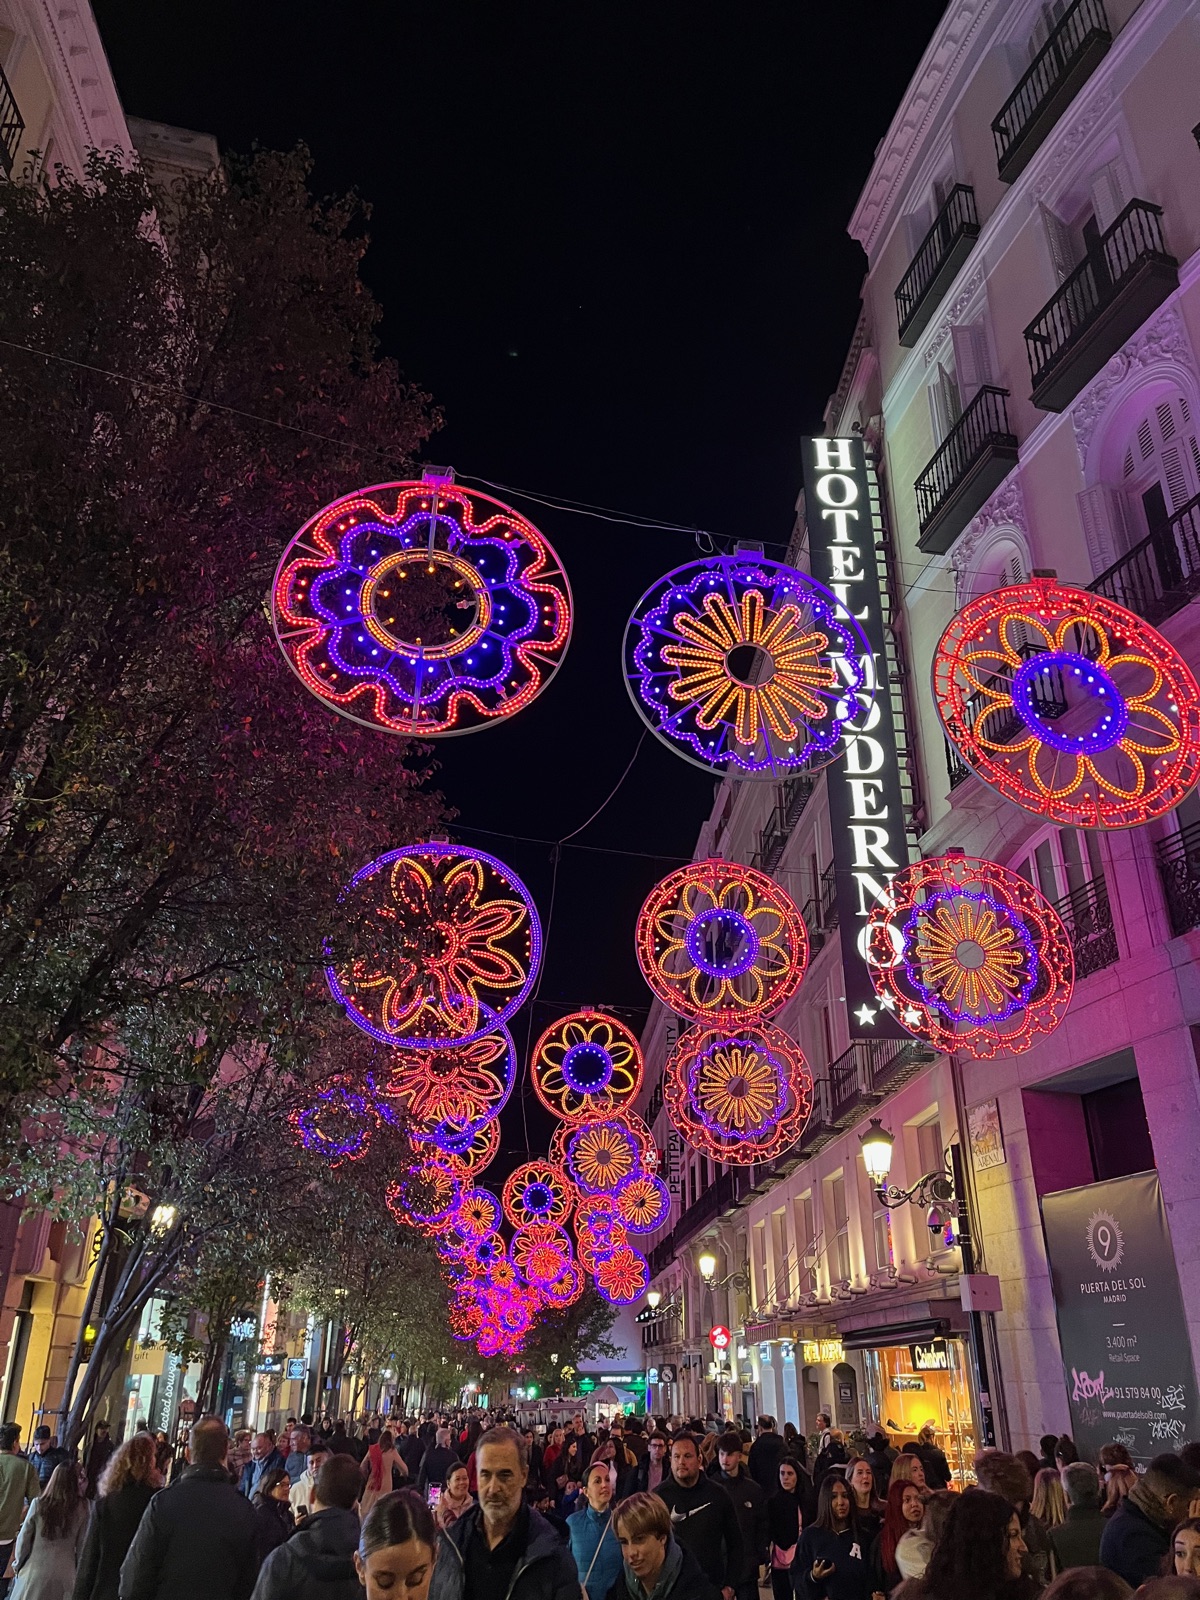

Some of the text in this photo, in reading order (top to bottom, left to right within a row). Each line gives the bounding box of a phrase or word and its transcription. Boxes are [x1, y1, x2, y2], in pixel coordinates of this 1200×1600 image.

[813, 437, 907, 968] HOTEL MODERNO
[1097, 1225, 1111, 1257] 9
[1080, 1277, 1147, 1294] PUERTA DEL SOL
[1103, 1294, 1127, 1303] MADRID
[1106, 1336, 1126, 1348] 3.400
[134, 1351, 149, 1361] gift
[1108, 1353, 1140, 1363] Retail Space
[158, 1351, 178, 1433] lected souveni
[1115, 1387, 1125, 1399] 91
[1125, 1387, 1139, 1399] 579
[1140, 1387, 1150, 1398] 84
[1151, 1387, 1161, 1399] 00
[1102, 1410, 1167, 1420] www.puertadelsol9.com
